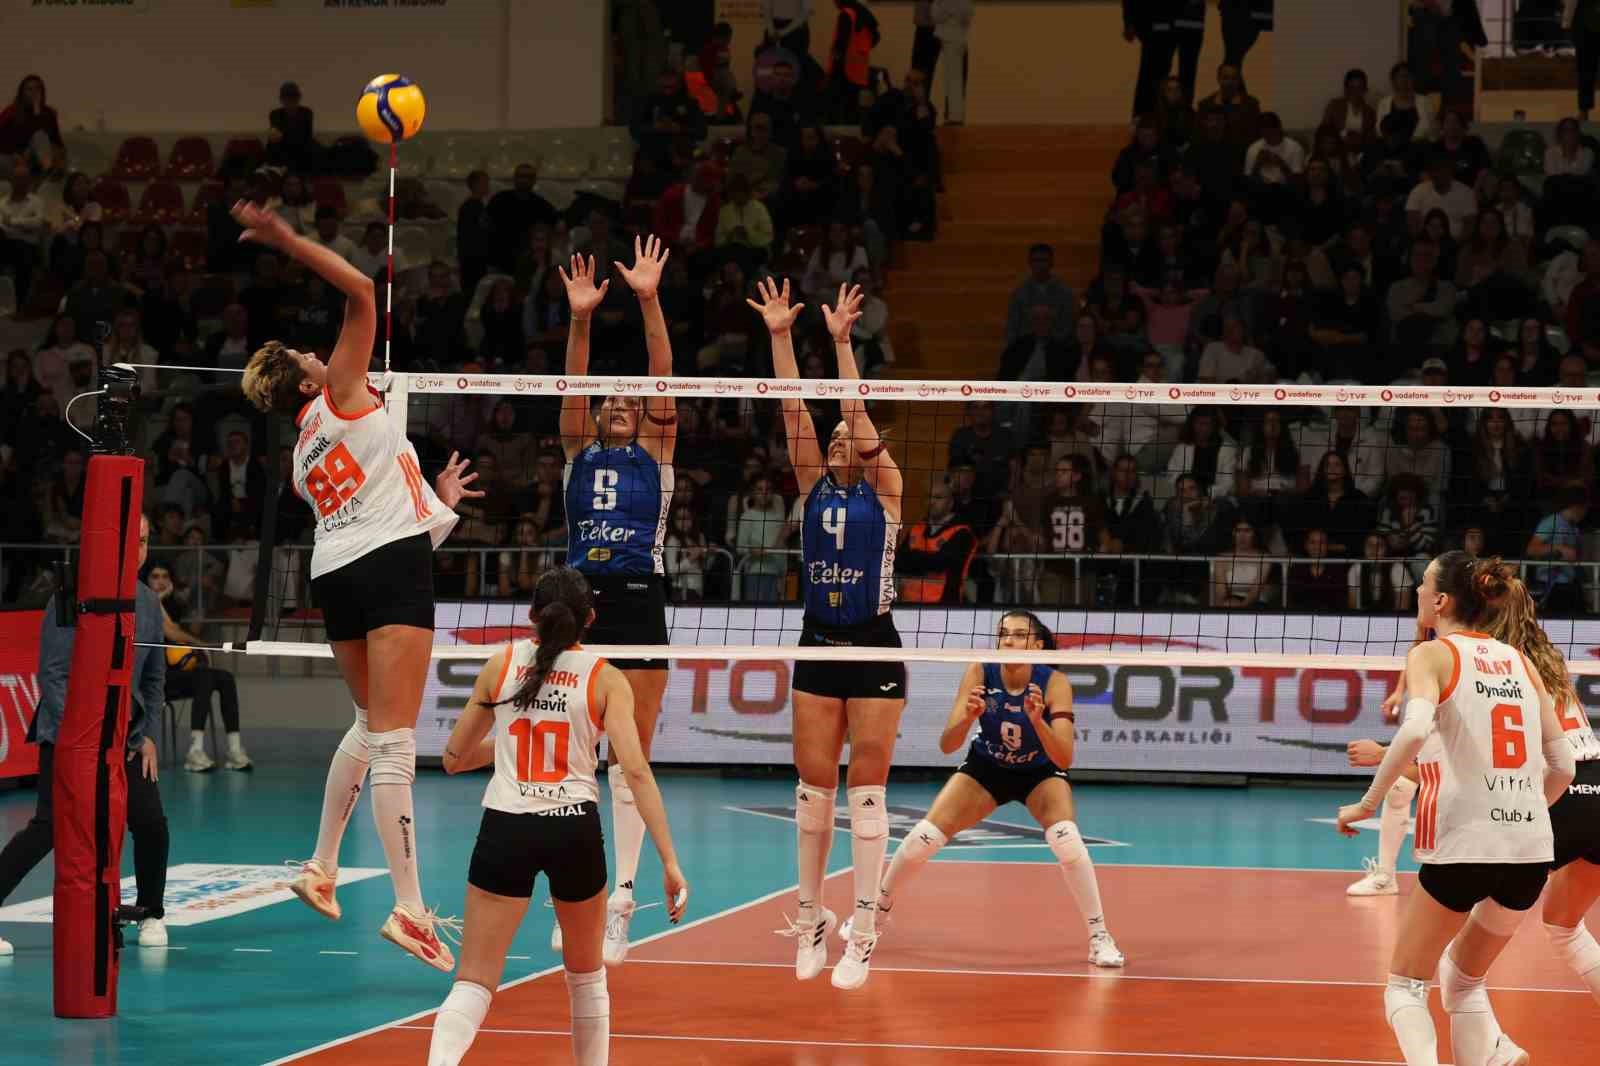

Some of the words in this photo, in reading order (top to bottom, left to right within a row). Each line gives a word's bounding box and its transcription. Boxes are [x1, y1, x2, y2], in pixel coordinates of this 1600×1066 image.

[428, 380, 443, 388] TVF
[470, 380, 501, 388] vodafone
[527, 382, 543, 390] TVF
[569, 381, 600, 389] vodafone
[669, 382, 701, 390] vodafone
[727, 384, 744, 392] TVF
[770, 384, 801, 392] vodafone
[871, 385, 904, 393] vodafone
[974, 387, 1007, 395] vodafone
[1034, 388, 1050, 396] TVF
[1077, 388, 1111, 396] vodafone
[1182, 389, 1216, 397] vodafone
[1287, 391, 1322, 399] vodafone
[1394, 391, 1429, 399] vodafone
[1502, 392, 1537, 400] vodafone
[822, 507, 847, 550] 4
[1475, 679, 1524, 699] Dynavit
[509, 718, 571, 783] 10
[1491, 703, 1528, 769] 6
[1490, 808, 1522, 823] Club
